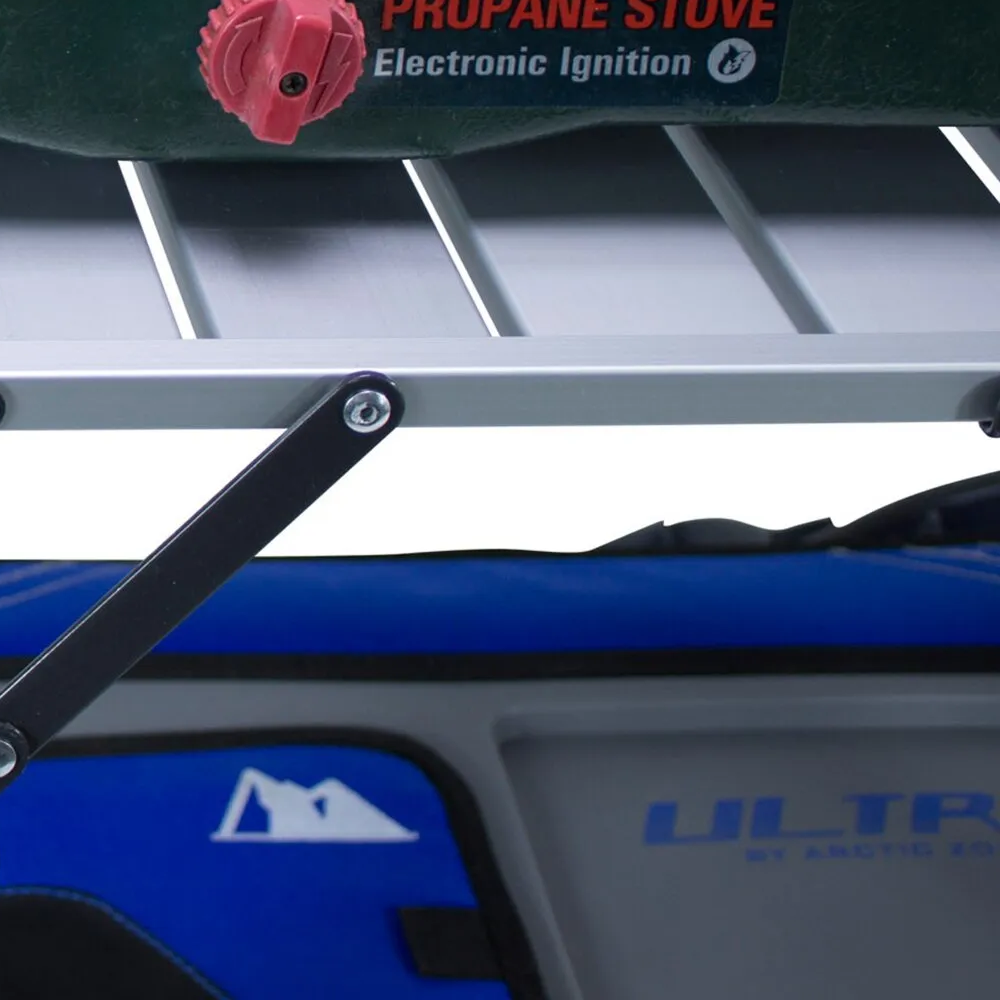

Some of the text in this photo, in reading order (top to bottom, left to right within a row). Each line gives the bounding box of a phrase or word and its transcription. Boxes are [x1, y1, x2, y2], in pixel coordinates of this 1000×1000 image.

[373, 46, 691, 82] Electronic Ignition
[643, 791, 1000, 846] ULTR
